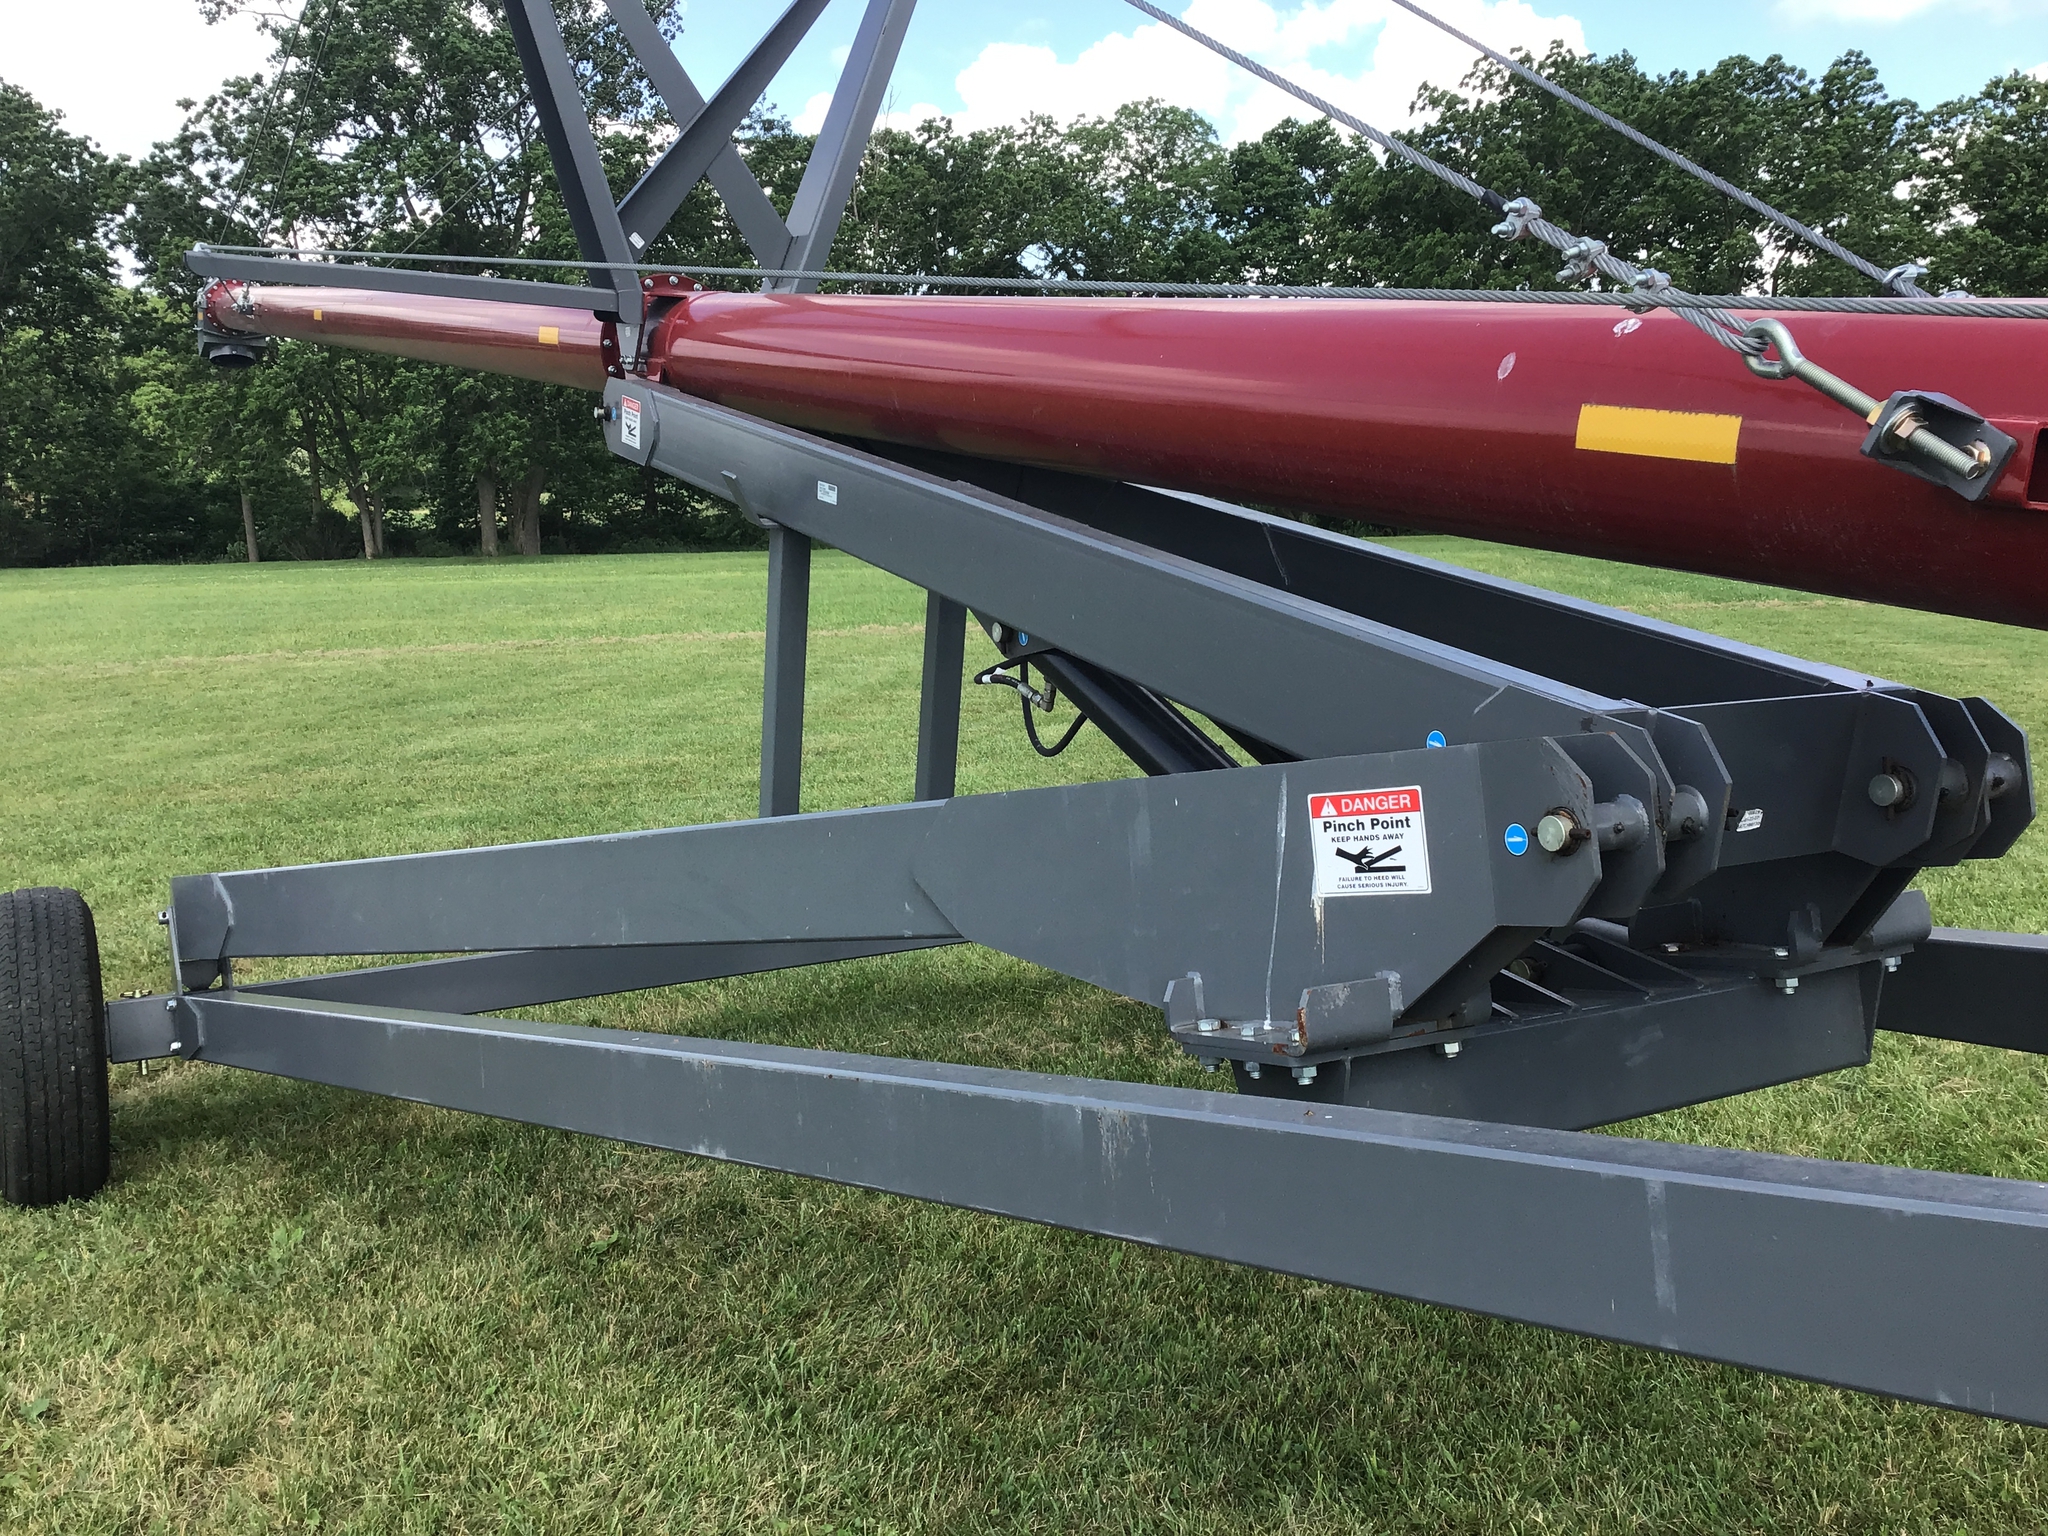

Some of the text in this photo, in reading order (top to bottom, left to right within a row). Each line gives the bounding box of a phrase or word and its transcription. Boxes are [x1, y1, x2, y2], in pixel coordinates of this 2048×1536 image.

[1341, 794, 1411, 812] DANGER
[1323, 816, 1411, 832] Pinch Point
